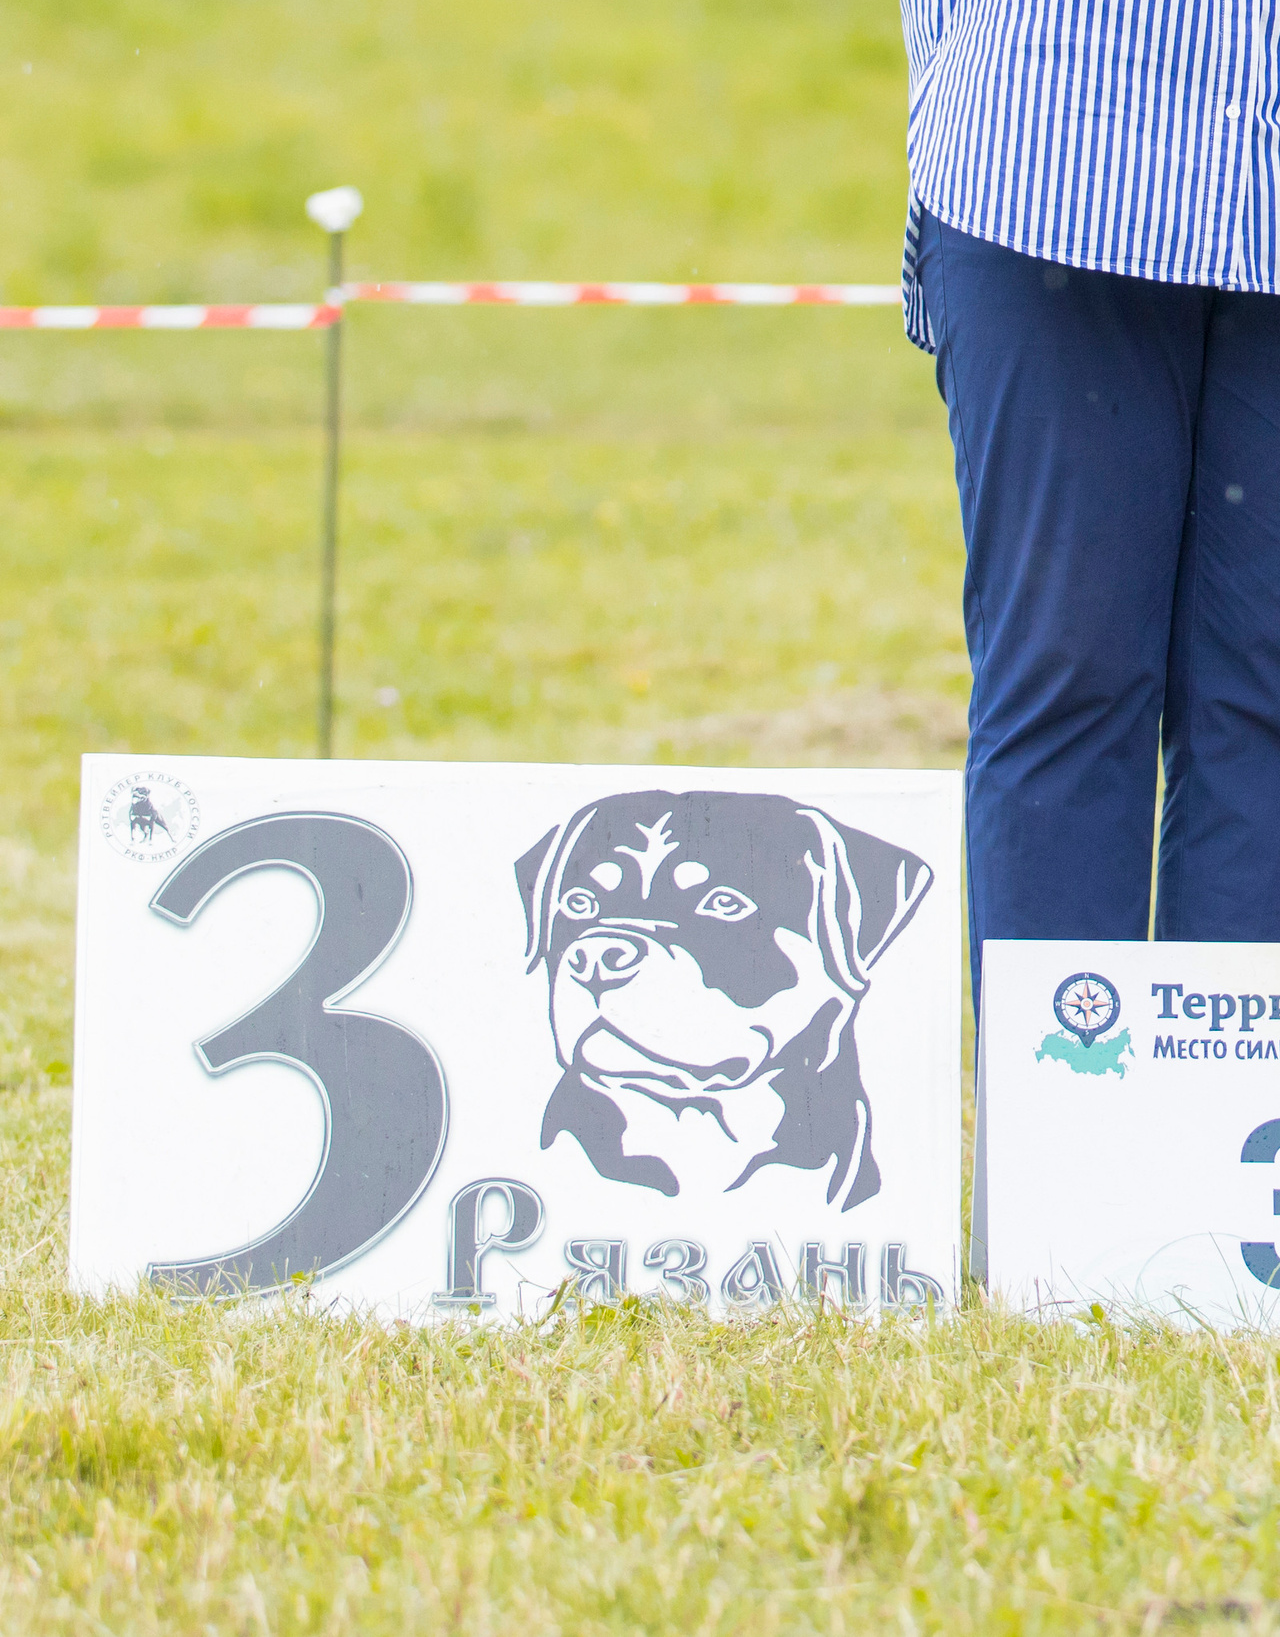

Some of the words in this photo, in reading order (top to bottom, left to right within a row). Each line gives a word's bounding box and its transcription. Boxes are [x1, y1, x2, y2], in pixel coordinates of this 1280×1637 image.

[148, 773, 182, 788] КЛУБ
[184, 790, 200, 839] РОССИИ
[146, 810, 450, 1304] 3
[433, 1177, 945, 1306] Рязань
